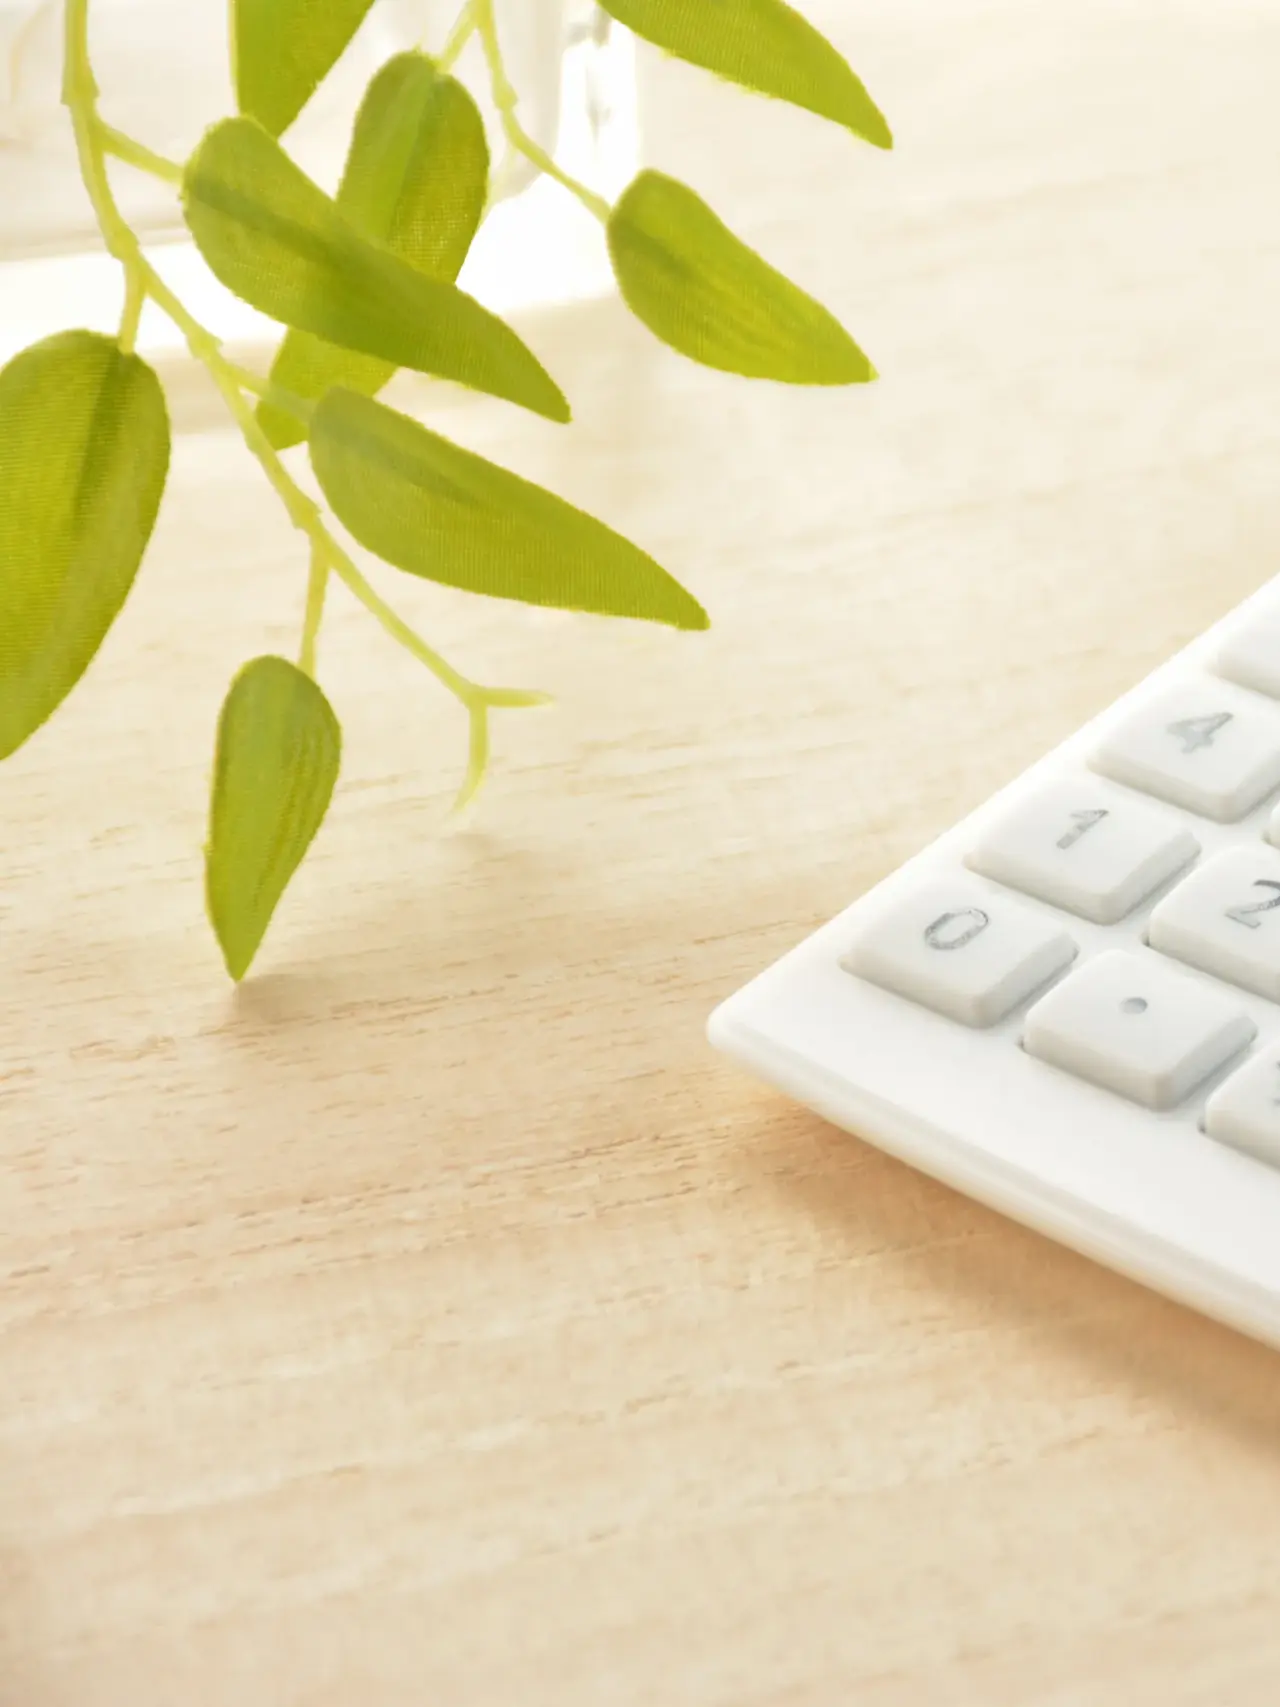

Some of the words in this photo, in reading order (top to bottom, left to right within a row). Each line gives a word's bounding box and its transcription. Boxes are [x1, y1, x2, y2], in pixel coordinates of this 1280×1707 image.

[1166, 711, 1235, 755] 4
[1055, 808, 1110, 852] 1
[922, 908, 990, 952] 0
